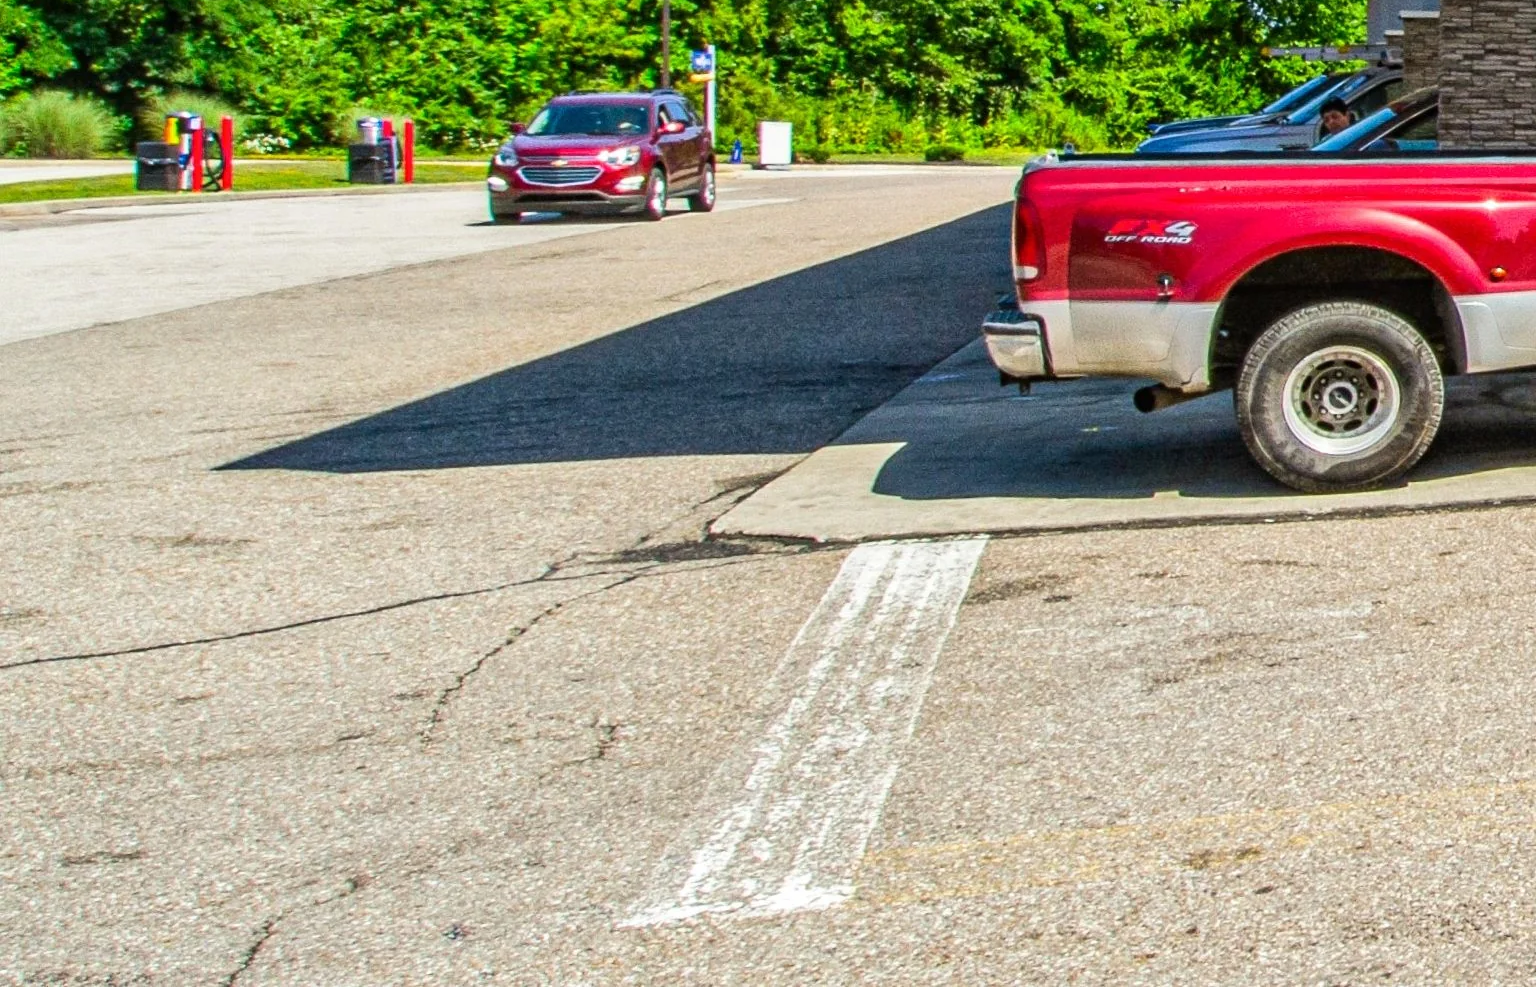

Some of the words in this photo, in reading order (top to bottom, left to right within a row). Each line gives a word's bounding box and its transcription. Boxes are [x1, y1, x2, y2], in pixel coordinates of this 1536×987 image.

[1108, 220, 1198, 237] FX4
[1104, 235, 1137, 243] OFF
[1140, 235, 1192, 244] ROAD
